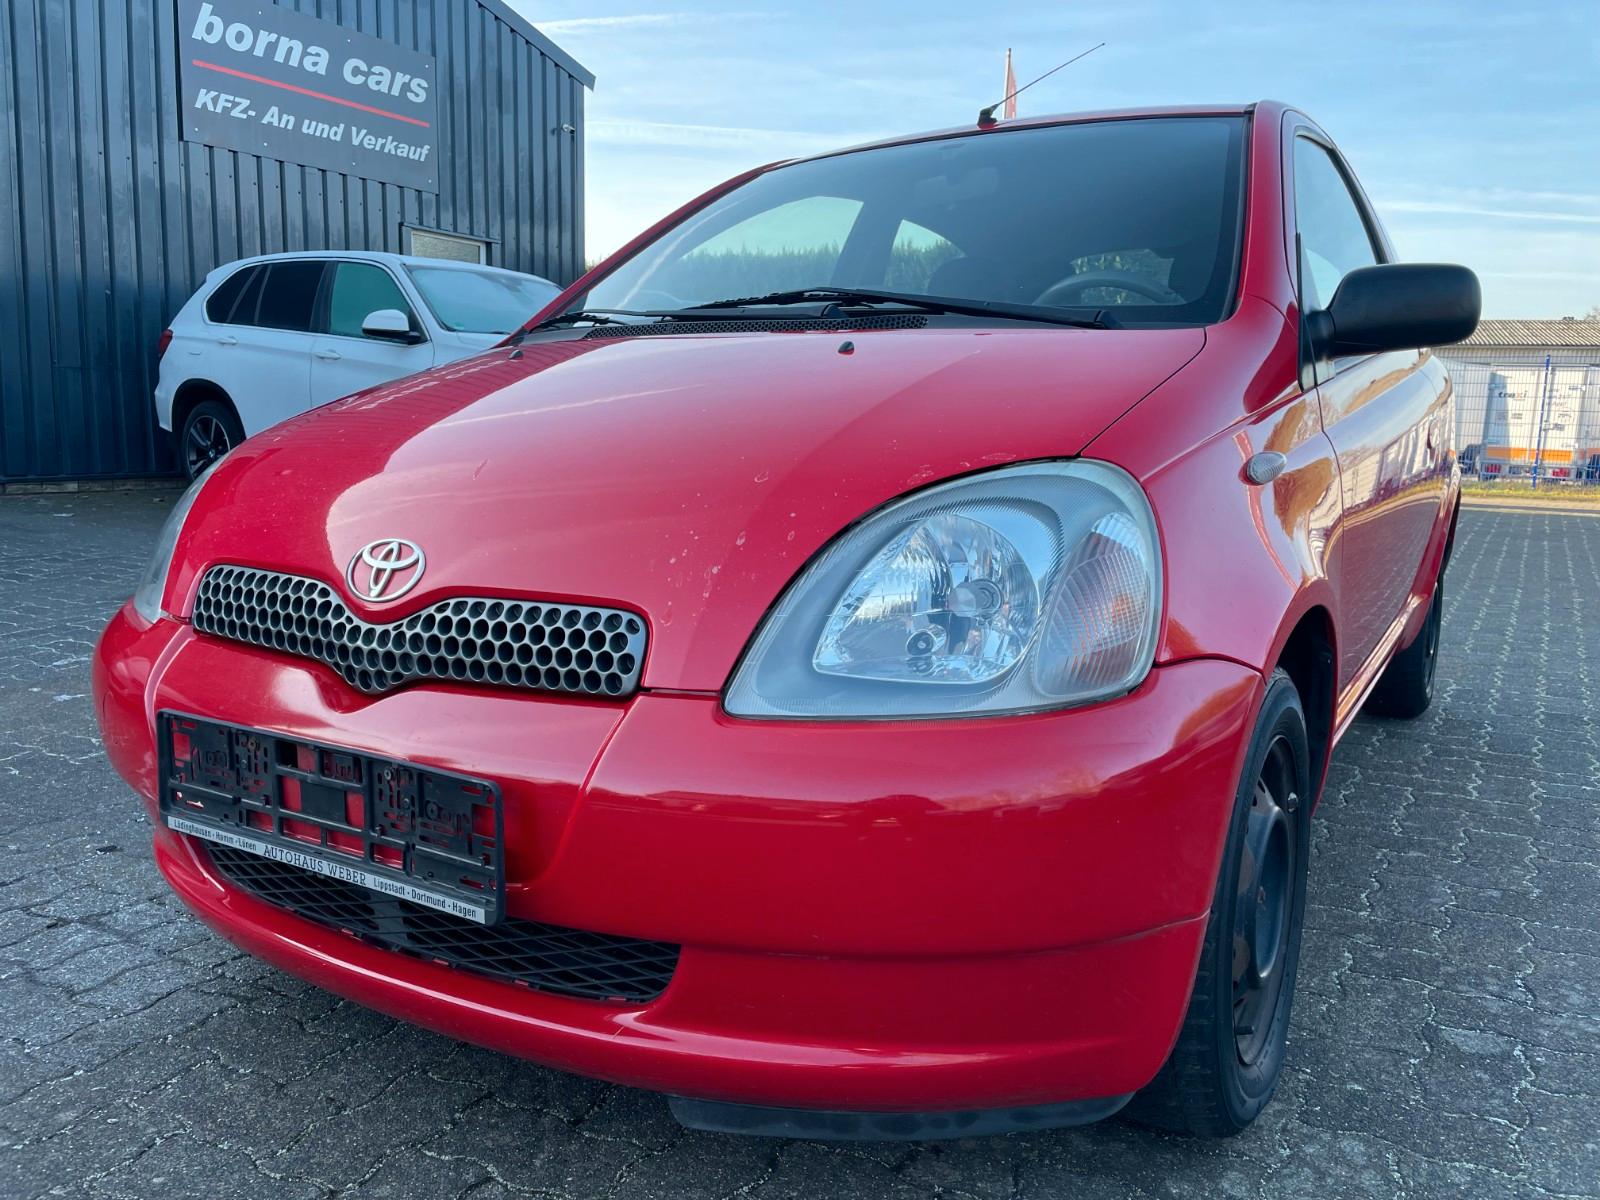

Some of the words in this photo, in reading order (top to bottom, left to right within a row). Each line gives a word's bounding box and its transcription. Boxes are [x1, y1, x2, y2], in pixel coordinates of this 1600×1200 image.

[191, 2, 330, 76] borna
[342, 57, 429, 103] cars
[194, 88, 256, 120] KFZ-
[260, 105, 296, 130] An
[301, 119, 345, 142] und
[350, 126, 431, 162] Verkauf
[263, 844, 324, 873] AUTOHAUS
[327, 862, 367, 885] WEBER
[373, 877, 405, 896] Lippstadt
[411, 889, 446, 908] Dortmund
[452, 901, 476, 918] Hagen
